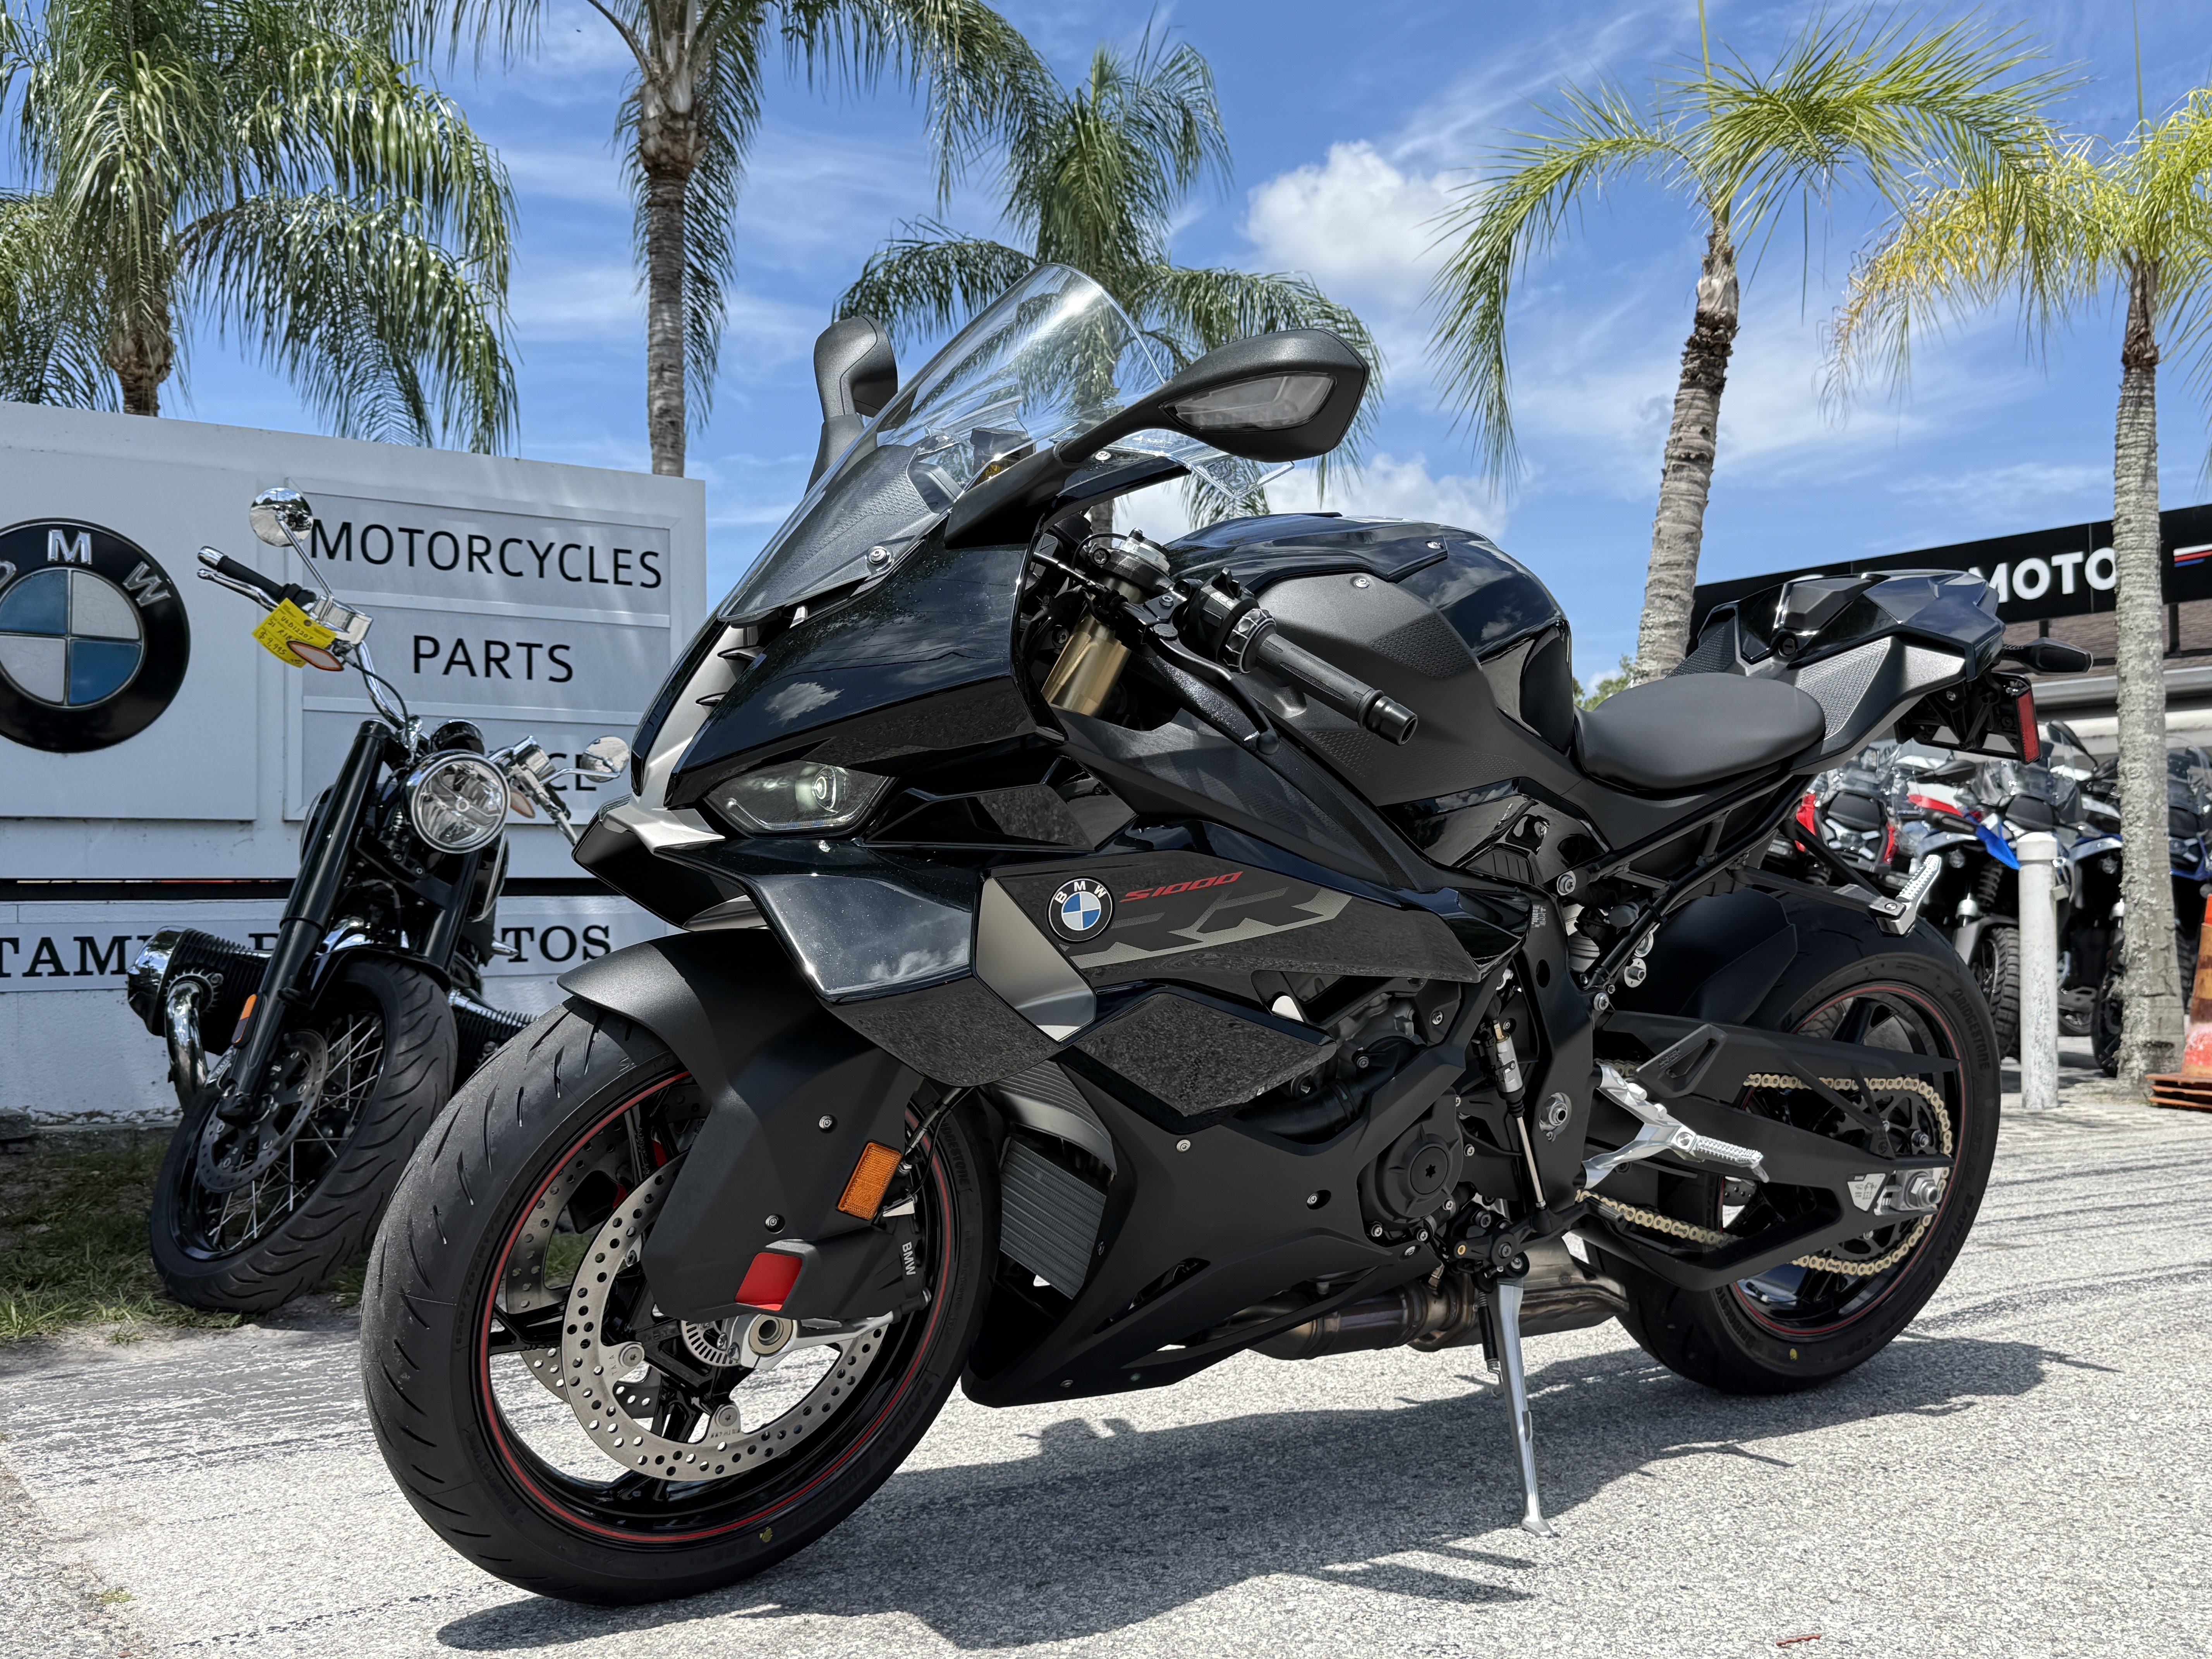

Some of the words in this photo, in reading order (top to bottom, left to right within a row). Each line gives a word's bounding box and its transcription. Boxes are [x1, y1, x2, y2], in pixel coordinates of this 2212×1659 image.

[0, 529, 171, 608] MW
[311, 519, 661, 588] MOTORCYCLES
[413, 635, 573, 683] PARTS
[1055, 880, 1107, 905] BMW
[1119, 871, 1244, 903] S1000
[0, 935, 152, 977] TAM
[901, 1241, 916, 1276] BMW
